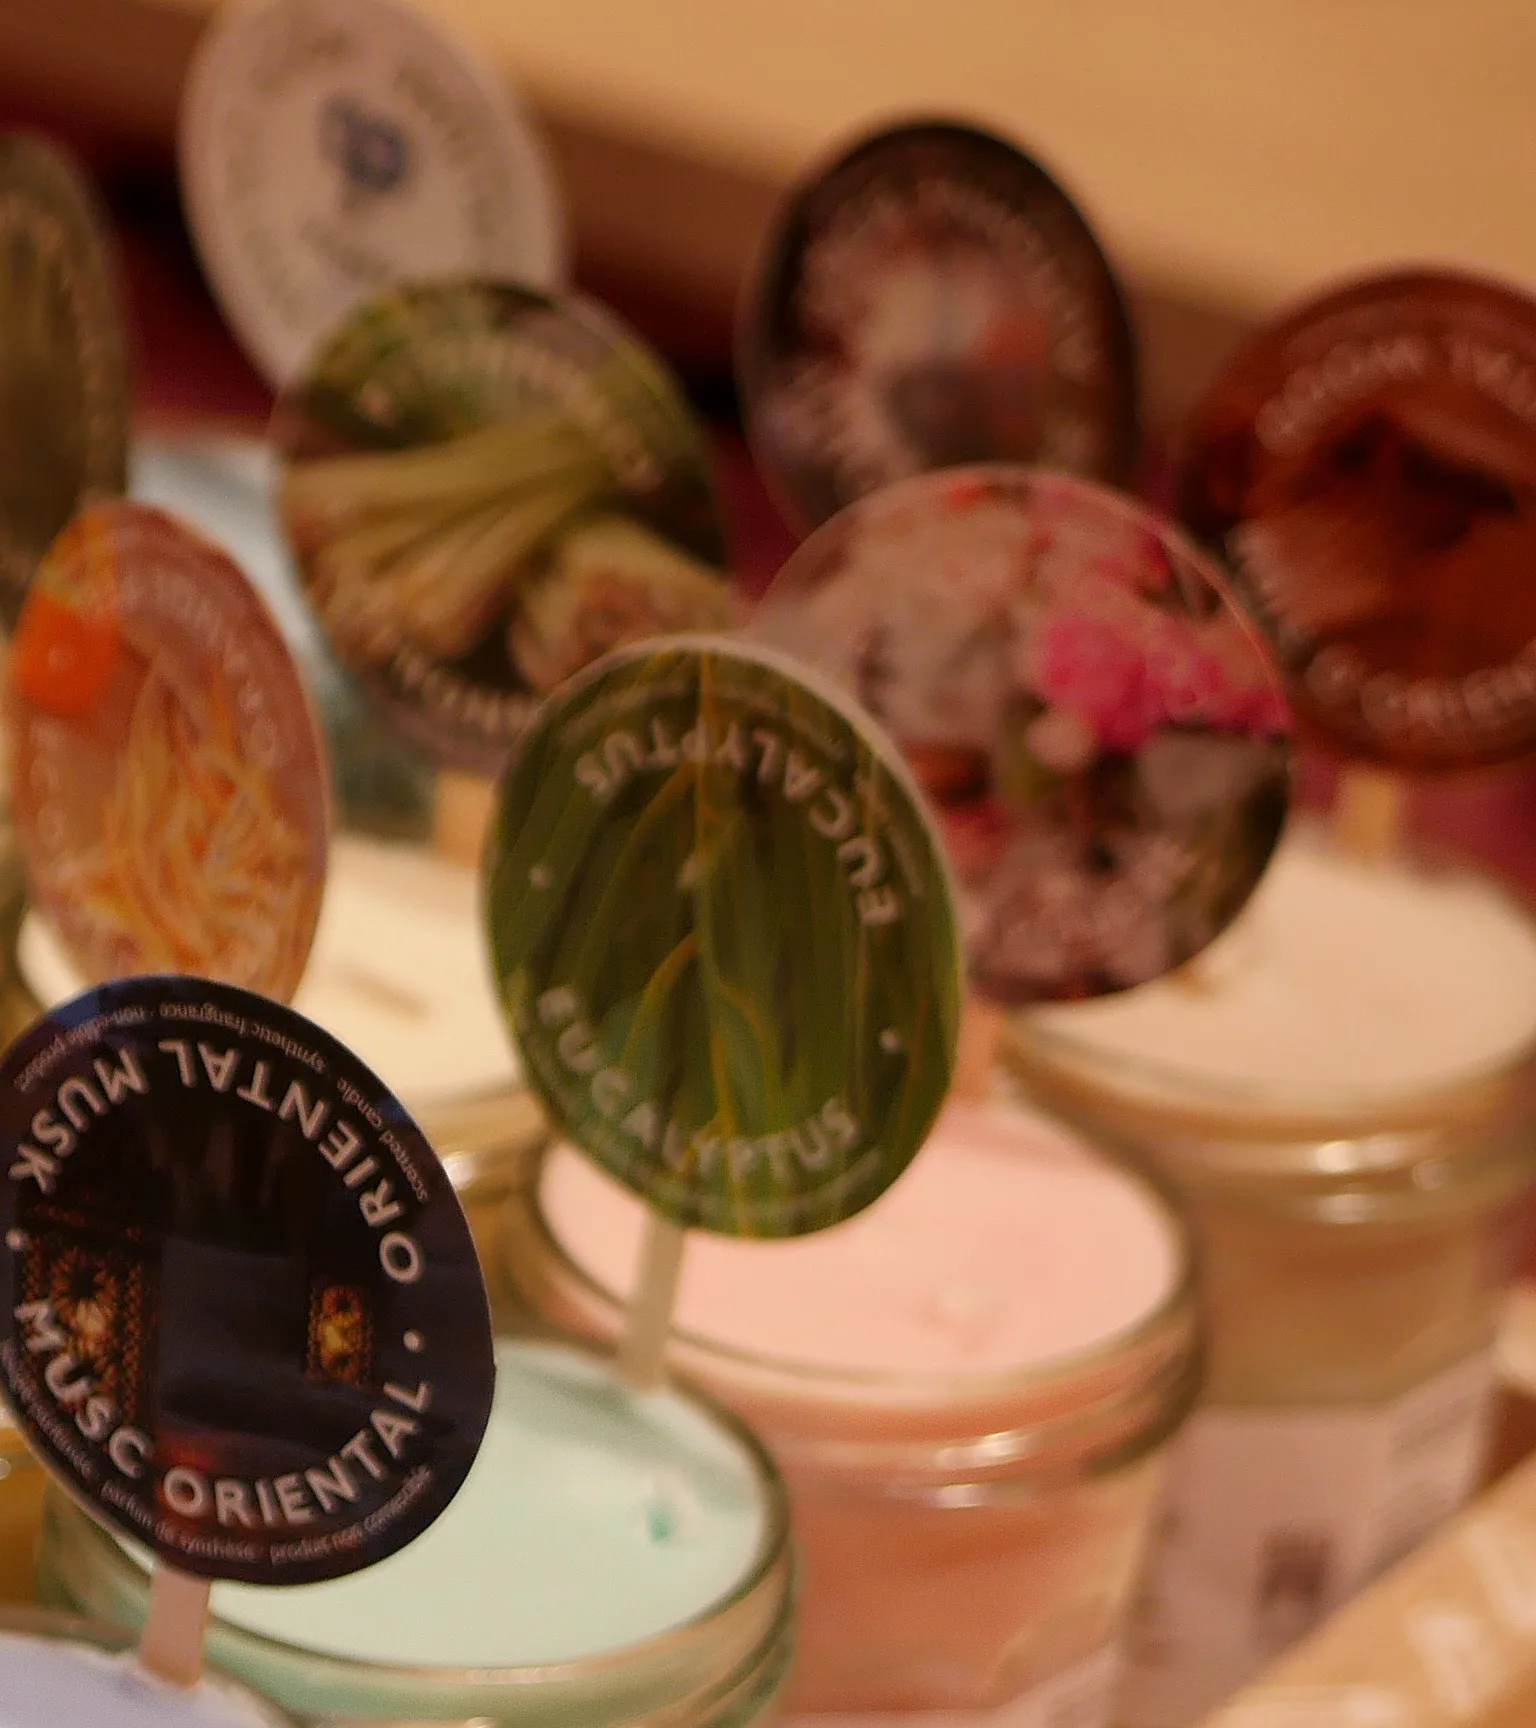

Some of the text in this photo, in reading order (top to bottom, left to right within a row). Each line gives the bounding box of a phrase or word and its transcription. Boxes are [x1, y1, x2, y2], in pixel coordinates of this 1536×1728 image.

[575, 714, 901, 926] EUCALYPTUS
[7, 1038, 424, 1284] ORIENTAL MUSK
[537, 984, 859, 1182] EUCALYPTUS
[14, 1300, 154, 1479] MUSC
[163, 1378, 432, 1529] ORIENTAL
